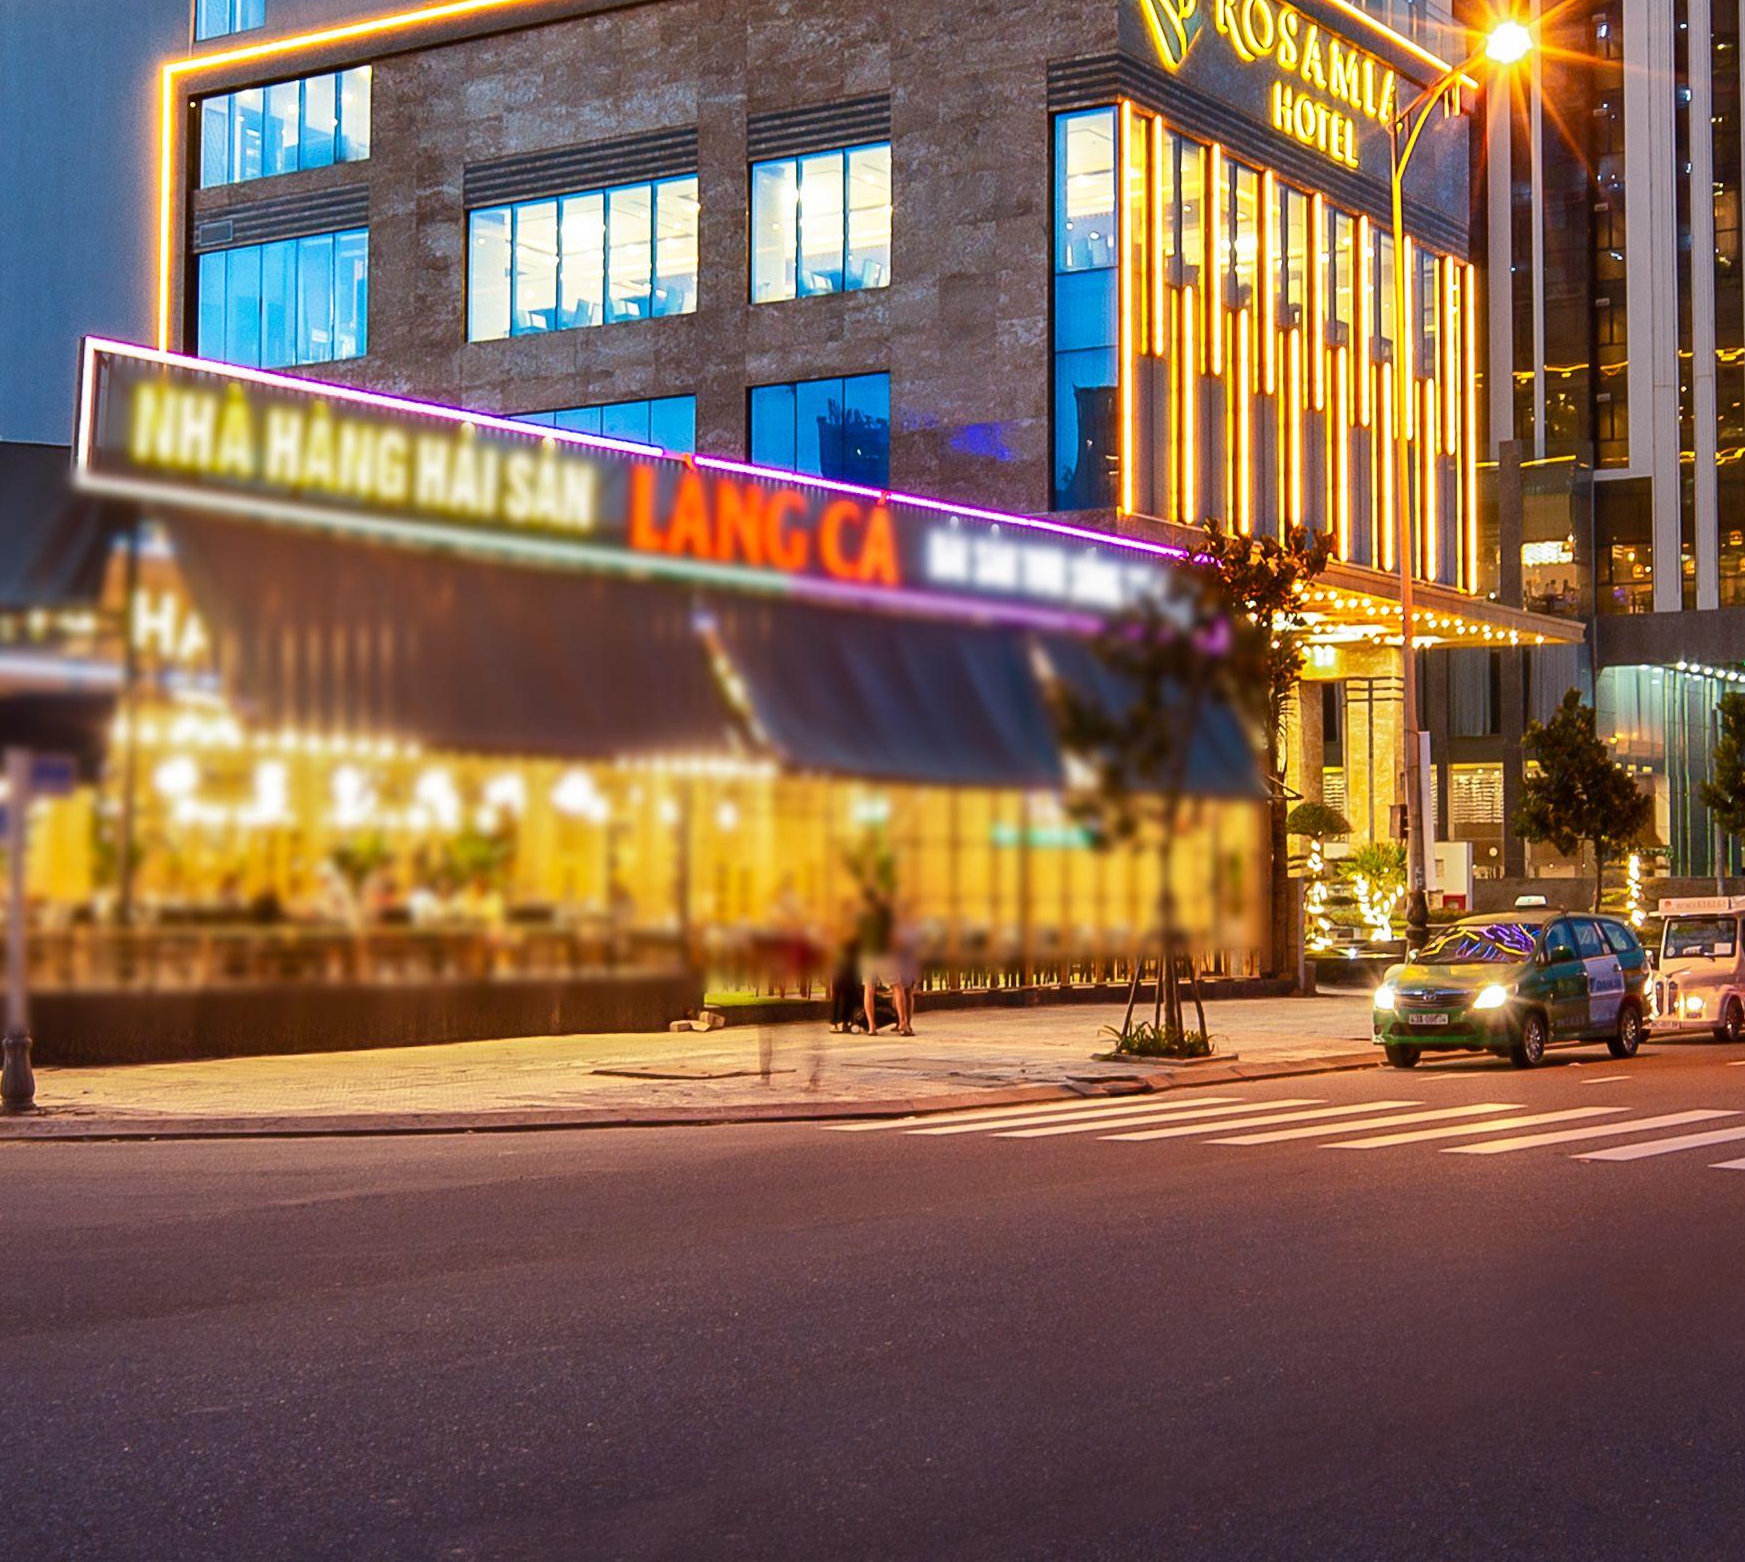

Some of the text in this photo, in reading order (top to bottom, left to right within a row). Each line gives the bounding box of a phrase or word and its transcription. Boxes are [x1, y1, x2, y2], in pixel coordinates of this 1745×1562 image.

[1272, 80, 1359, 168] HOTEL
[630, 454, 808, 573] LÀNG
[819, 491, 900, 586] CÁ
